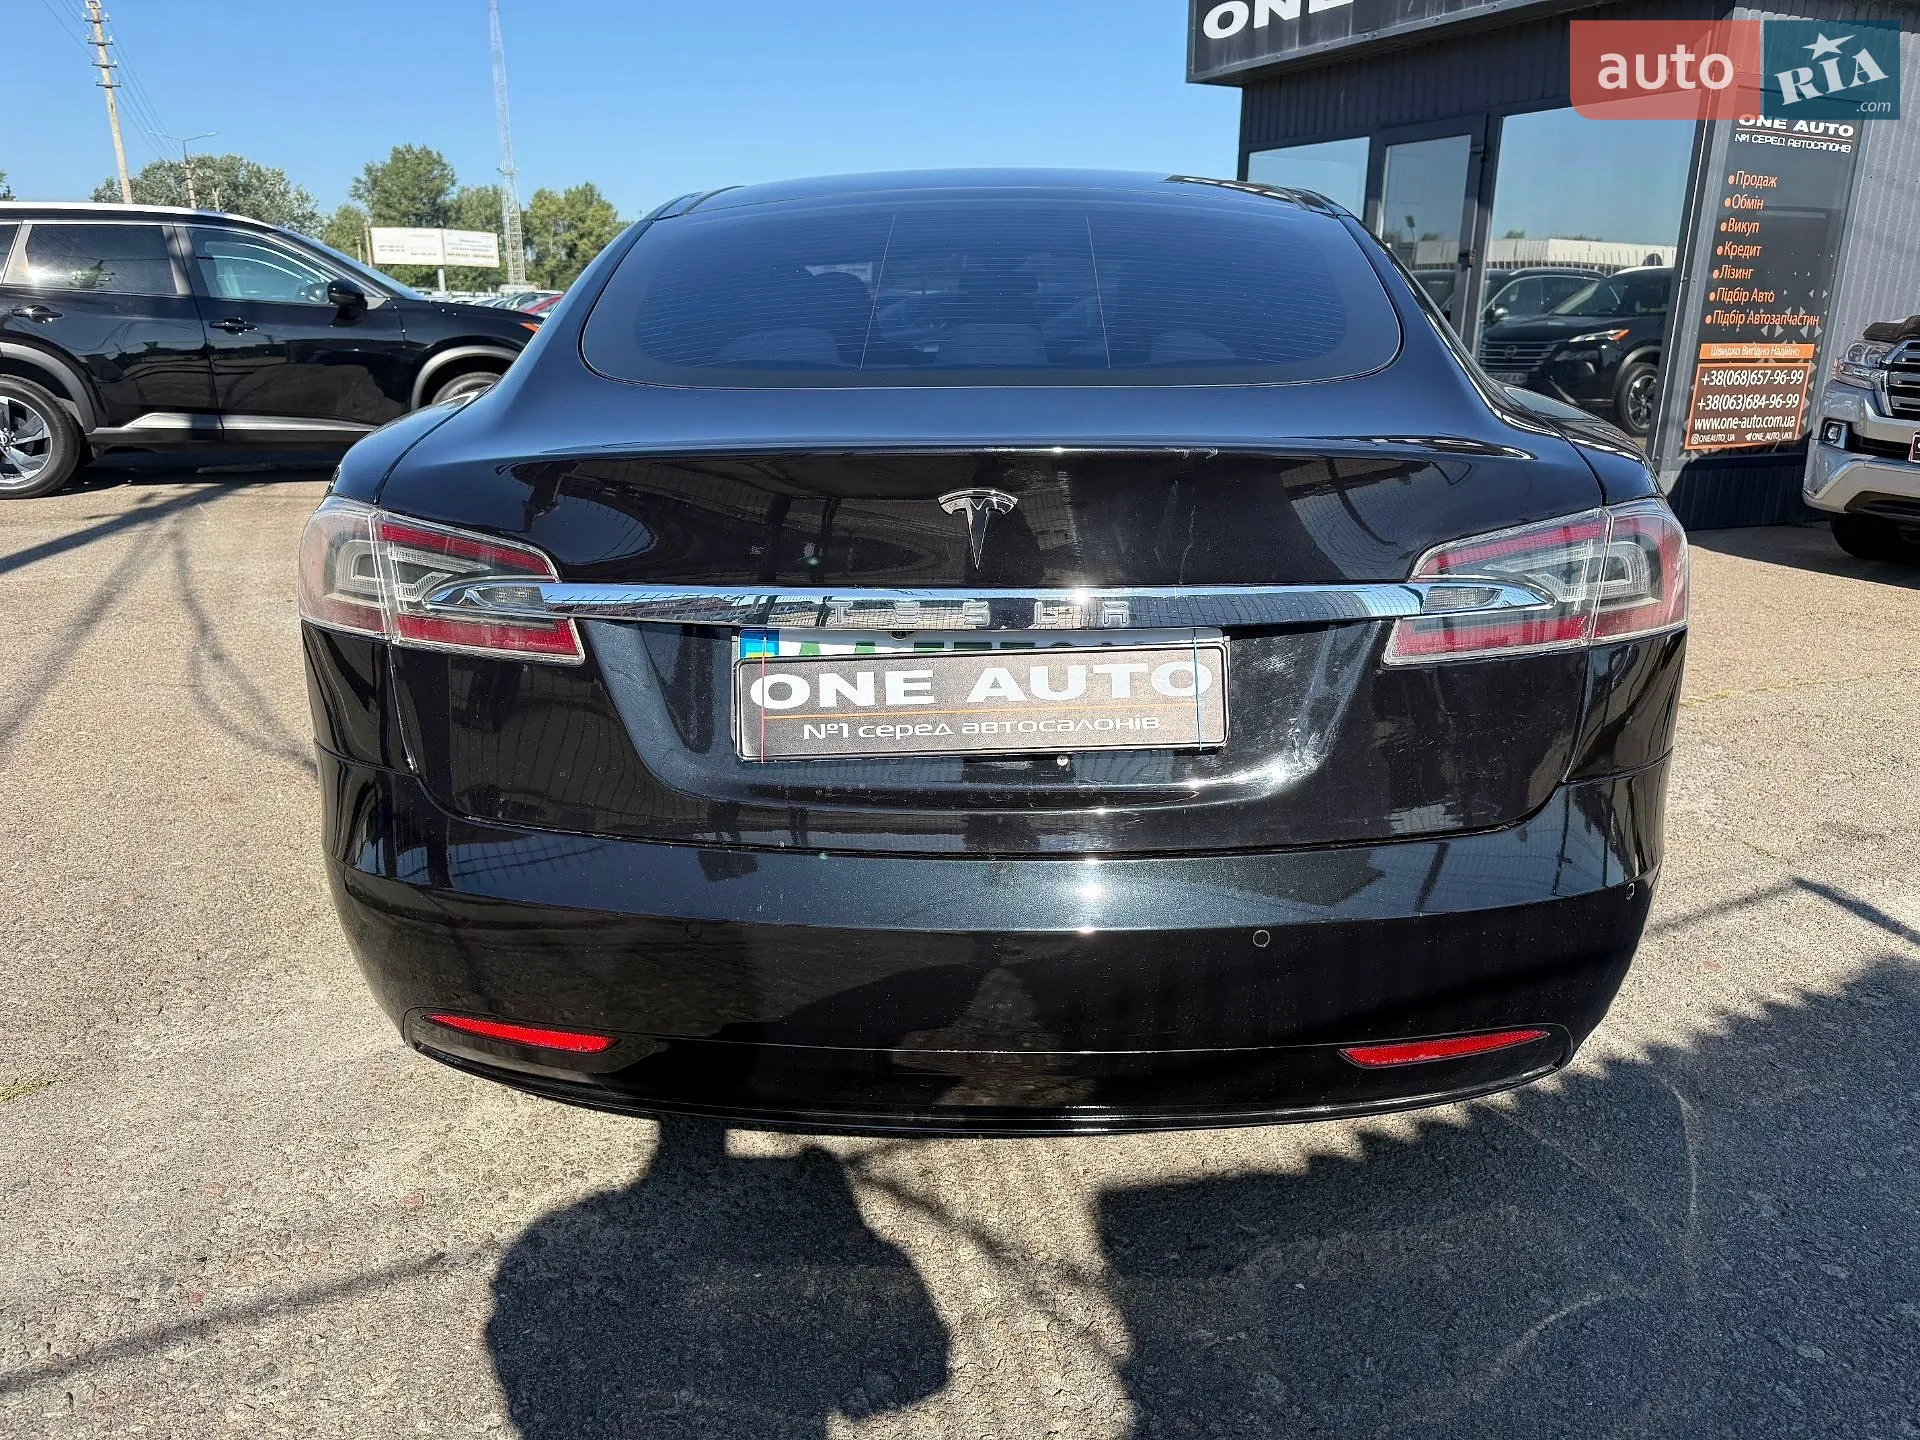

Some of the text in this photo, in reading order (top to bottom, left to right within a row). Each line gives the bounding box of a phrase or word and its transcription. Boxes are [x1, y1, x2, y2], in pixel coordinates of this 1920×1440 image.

[1202, 0, 1353, 39] ON
[1738, 114, 1855, 137] ONE AUTO
[1752, 134, 1785, 146] СЕРЕД
[1787, 138, 1852, 153] АВТОСАЛОНІВ
[1735, 170, 1778, 188] Продаж
[1732, 194, 1763, 210] Обмін
[1728, 218, 1759, 236] Викуп
[1723, 241, 1762, 259] Кредит
[1719, 264, 1754, 279] Лізинг
[1716, 287, 1775, 305] Підбір Авто
[1712, 309, 1819, 327] Підбір Автозапчастин
[1710, 345, 1740, 357] Швидко
[1770, 345, 1800, 357] Надійно
[1701, 370, 1804, 388] +38(068)657-96-99
[1697, 394, 1800, 412] +38(063)684-96-99
[1694, 414, 1796, 431] www.one-auto.com.ua
[826, 599, 1129, 627] TESLA
[750, 661, 1213, 710] ONE AUTO
[858, 722, 955, 740] серед
[961, 716, 1161, 735] автосалонів
